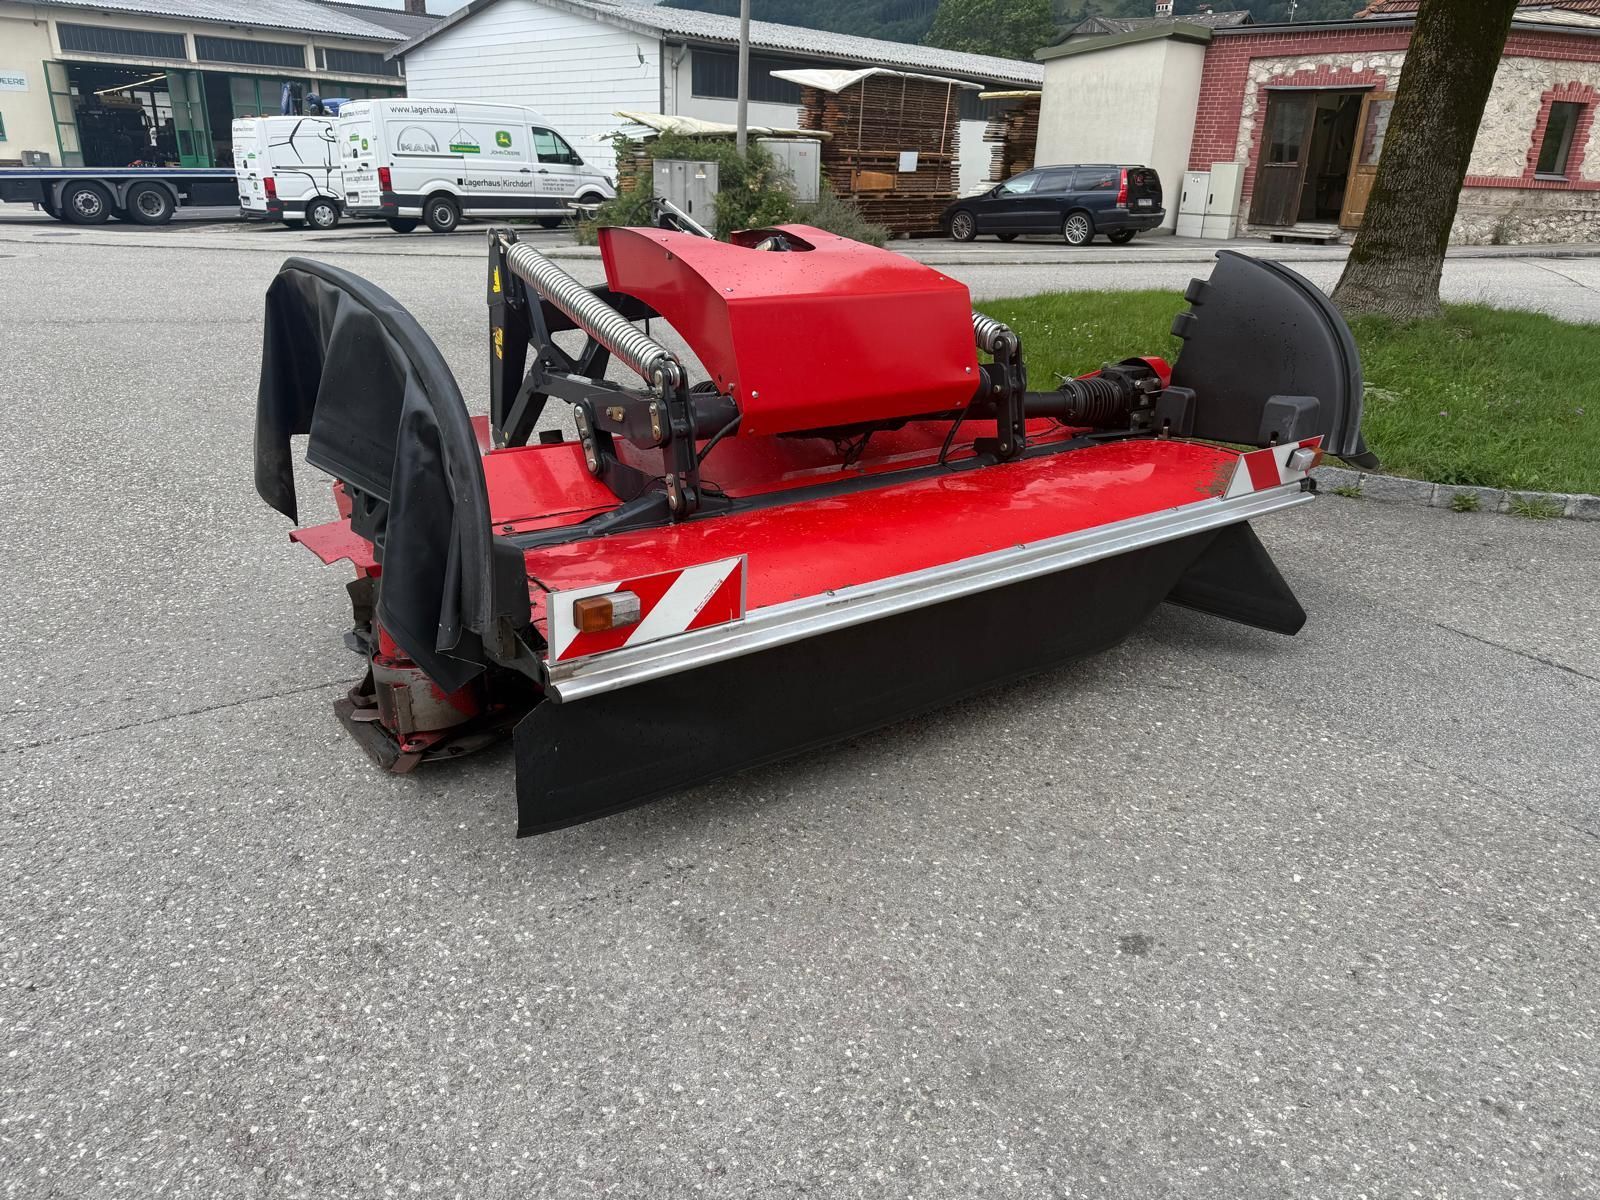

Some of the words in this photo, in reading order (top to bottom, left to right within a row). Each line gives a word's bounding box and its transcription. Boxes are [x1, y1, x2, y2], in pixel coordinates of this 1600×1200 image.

[390, 106, 456, 115] www.lagerhaus.at
[401, 143, 436, 152] MAN
[464, 179, 501, 187] Lagerhaus
[502, 179, 533, 187] Kirchdorf
